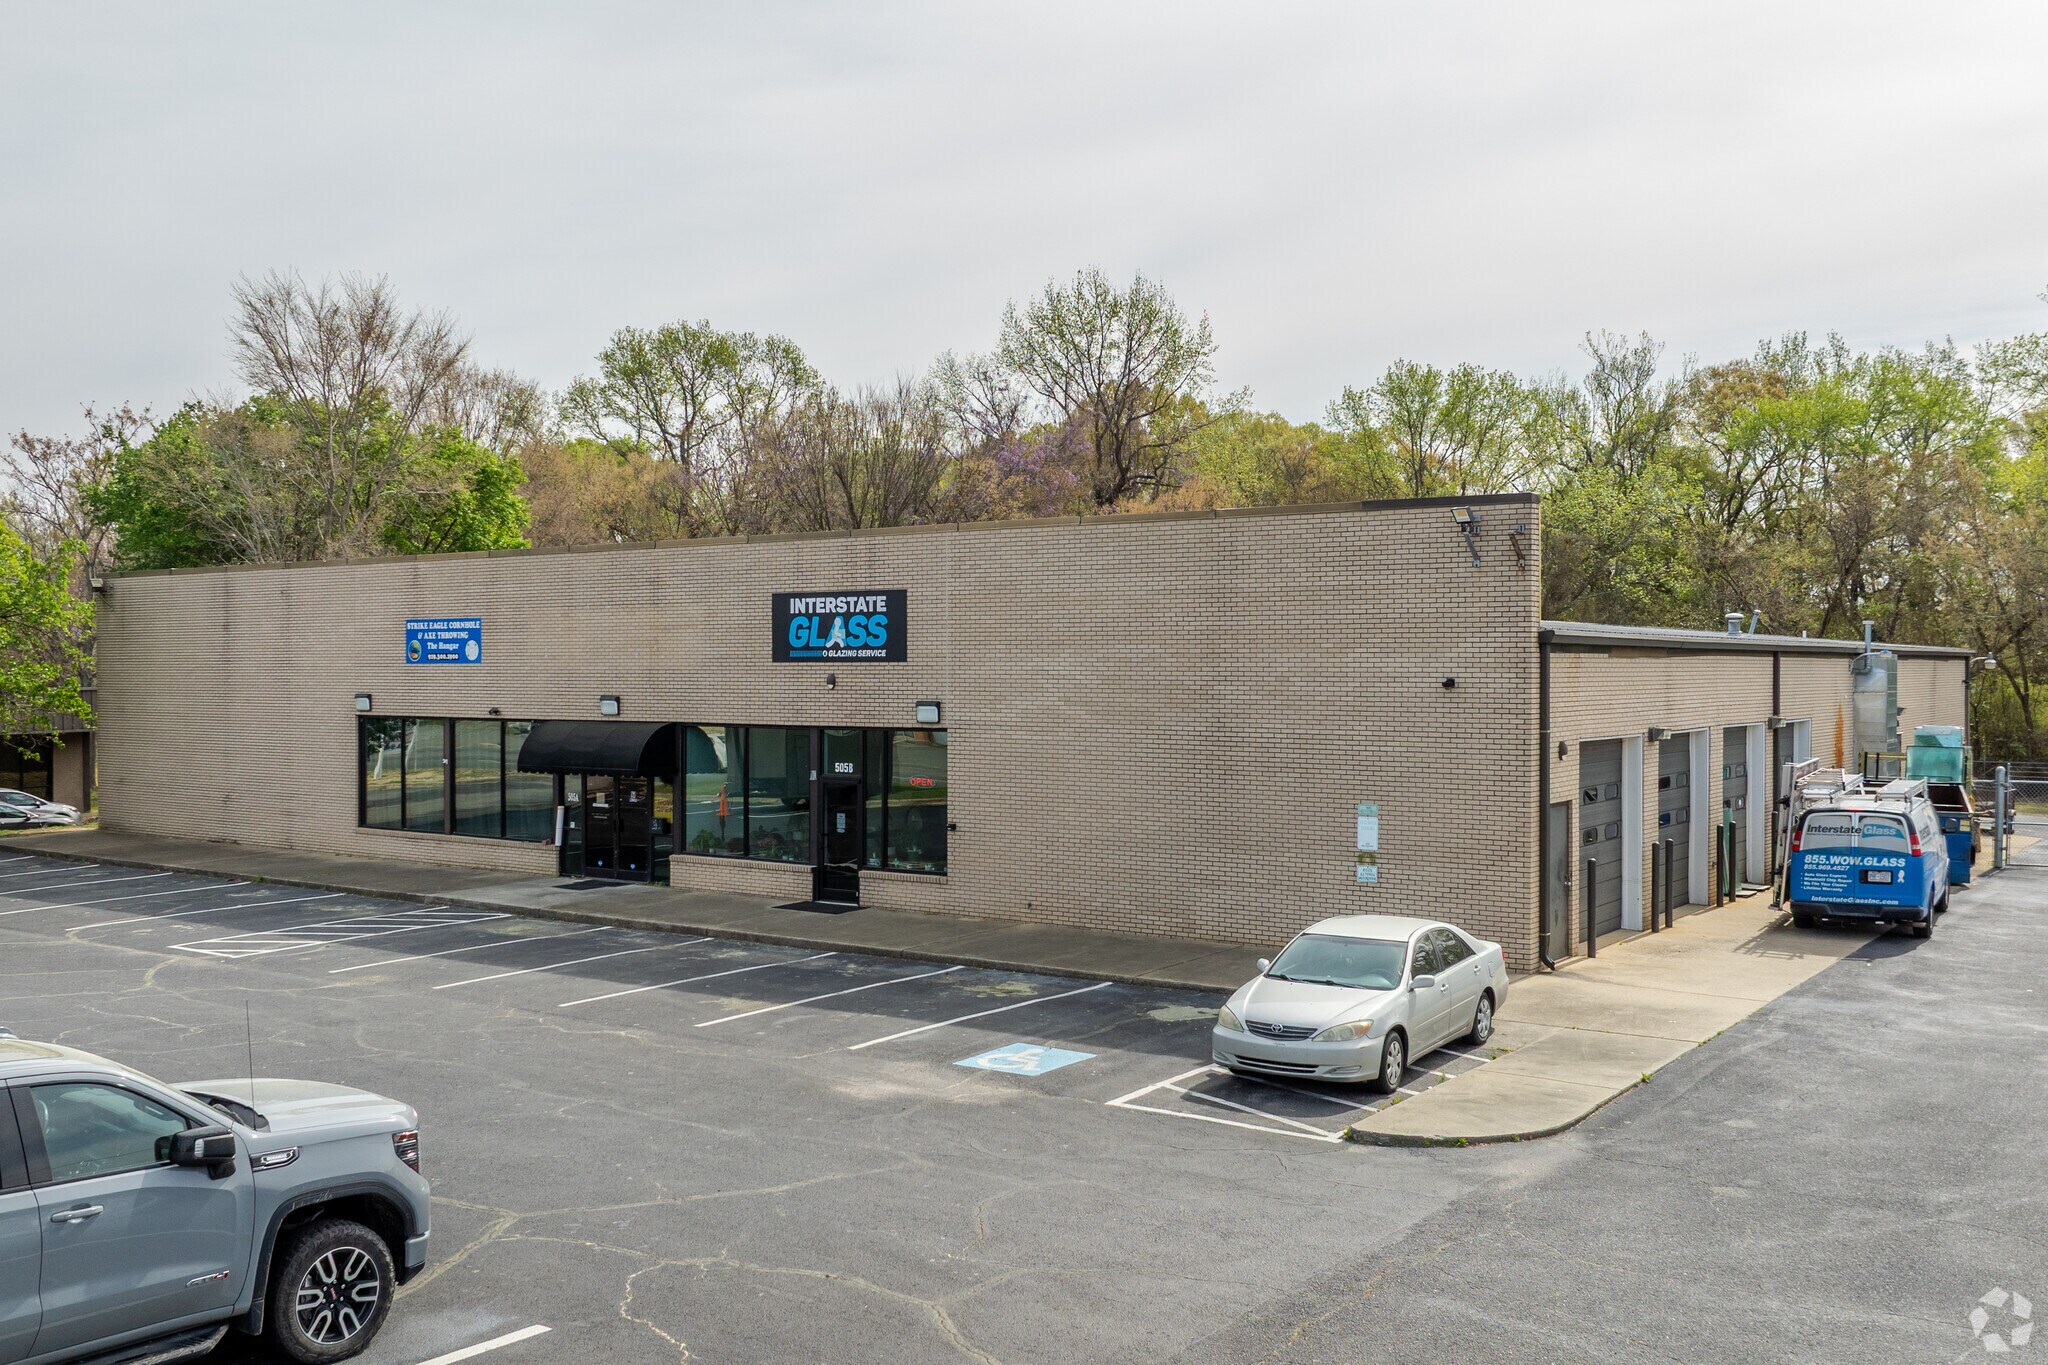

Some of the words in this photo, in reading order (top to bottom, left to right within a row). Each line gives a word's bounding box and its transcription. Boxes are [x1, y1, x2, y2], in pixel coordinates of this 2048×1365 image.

[790, 596, 886, 614] INTERSTATE
[407, 622, 428, 630] STRIKE
[449, 621, 480, 629] CORNHOLE
[789, 614, 888, 648] GLASS
[437, 631, 469, 639] THROWING
[427, 642, 437, 650] The
[438, 642, 459, 651] Hangar
[834, 762, 854, 774] 505B
[909, 776, 933, 787] OPEN
[567, 793, 579, 802] 505A
[1807, 824, 1862, 834] Interstate
[1863, 825, 1897, 836] Glass
[1804, 854, 1906, 867] 855.WOW.GLASS
[1811, 895, 1899, 905] InterstateGlassInc.com
